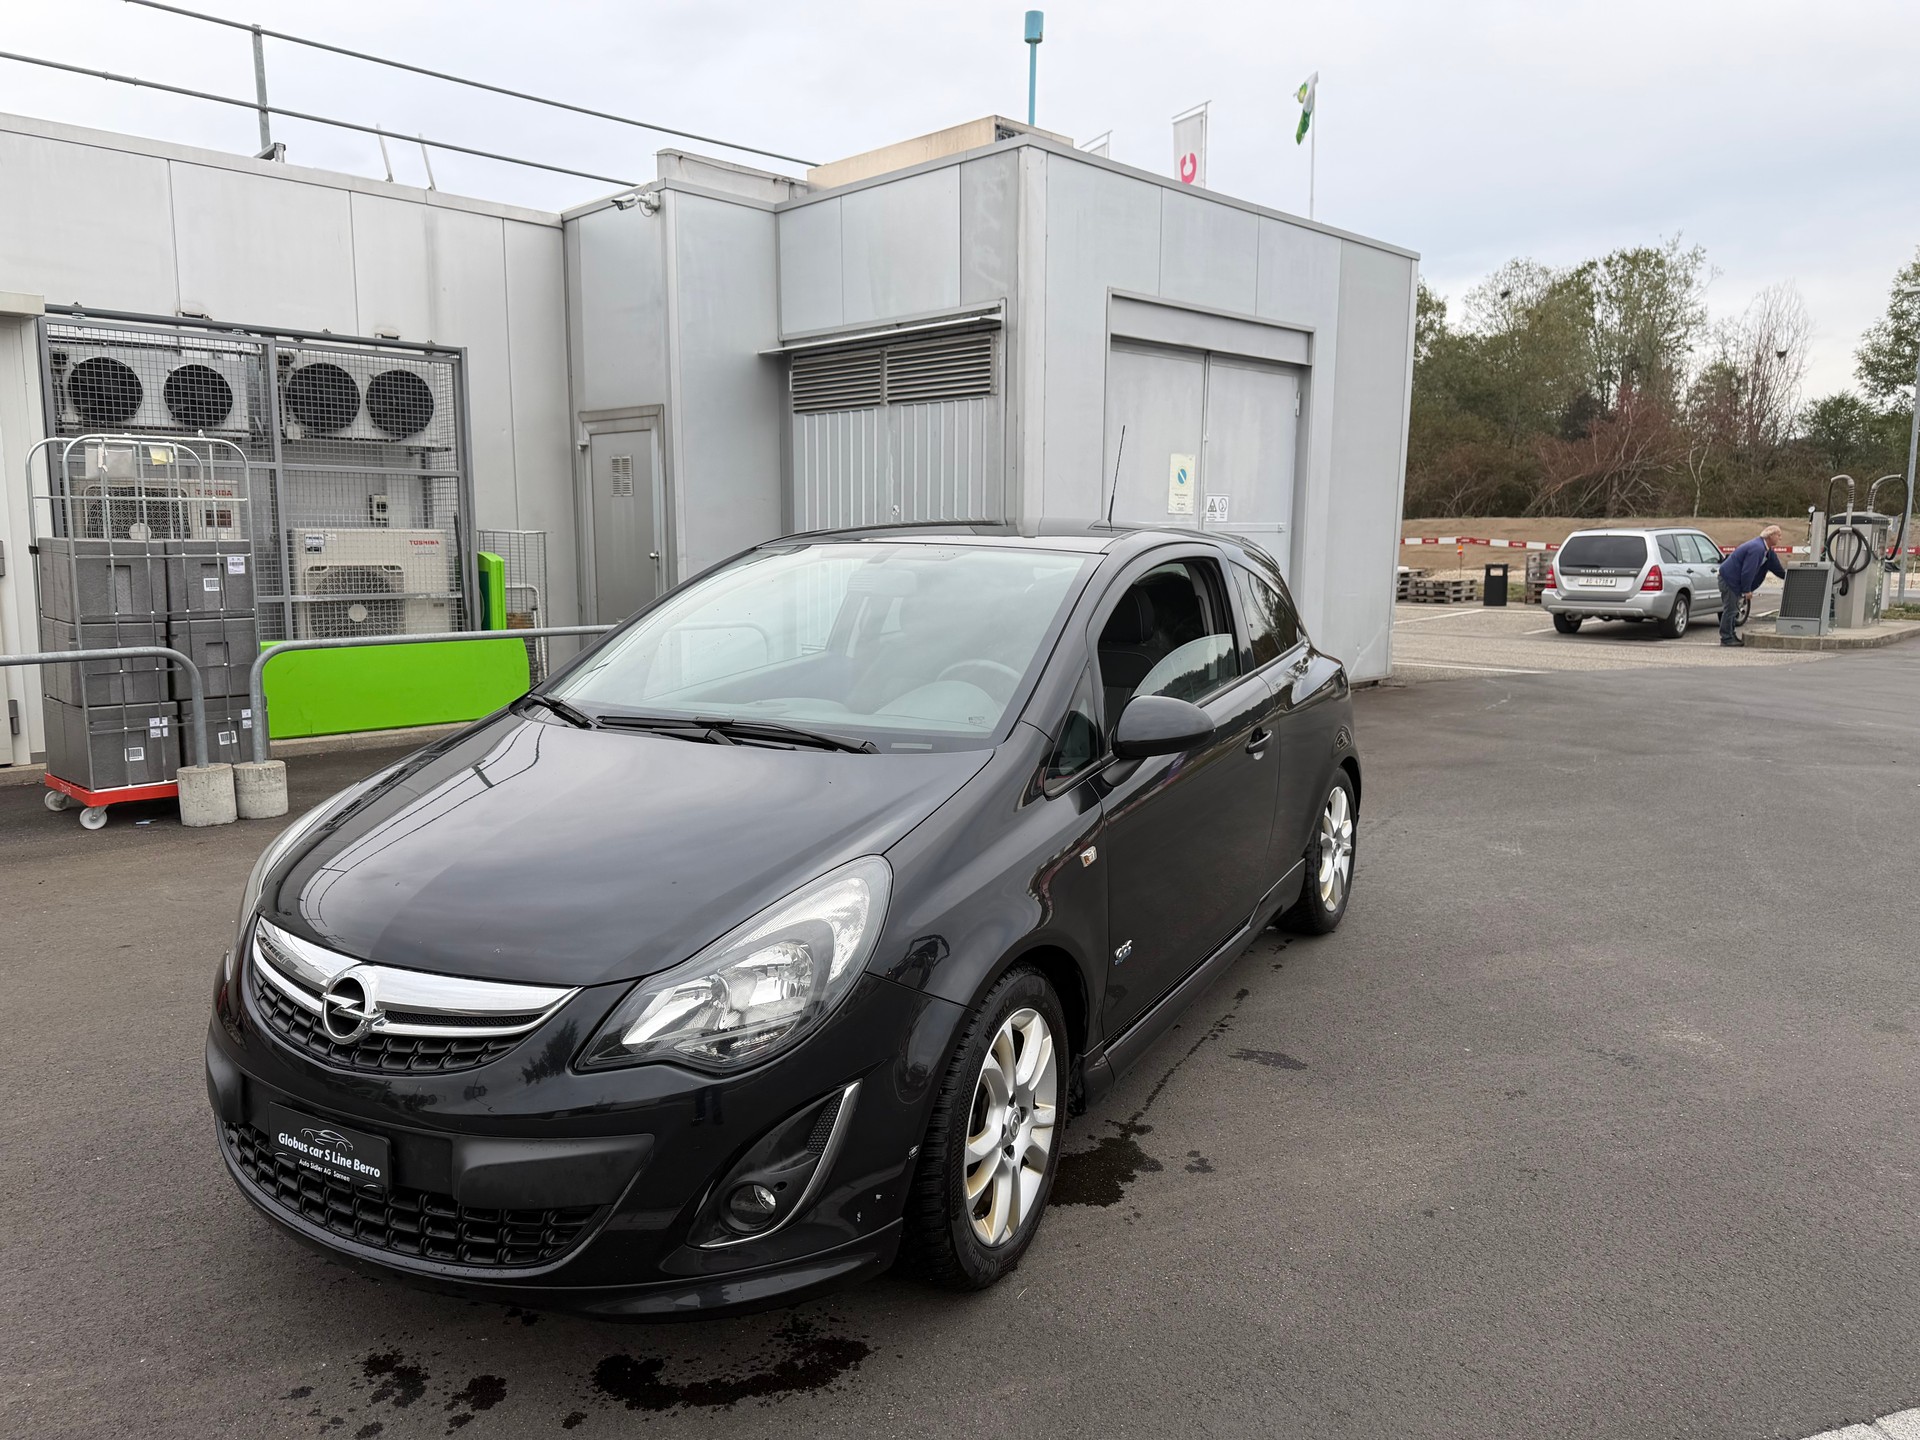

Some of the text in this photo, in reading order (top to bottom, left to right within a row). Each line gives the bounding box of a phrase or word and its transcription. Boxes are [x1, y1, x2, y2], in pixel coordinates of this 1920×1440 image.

[278, 1132, 381, 1178] Globus car S Line Berro
[299, 1158, 310, 1168] Auto
[323, 1168, 332, 1176] AG
[333, 1170, 351, 1182] Sarnen
